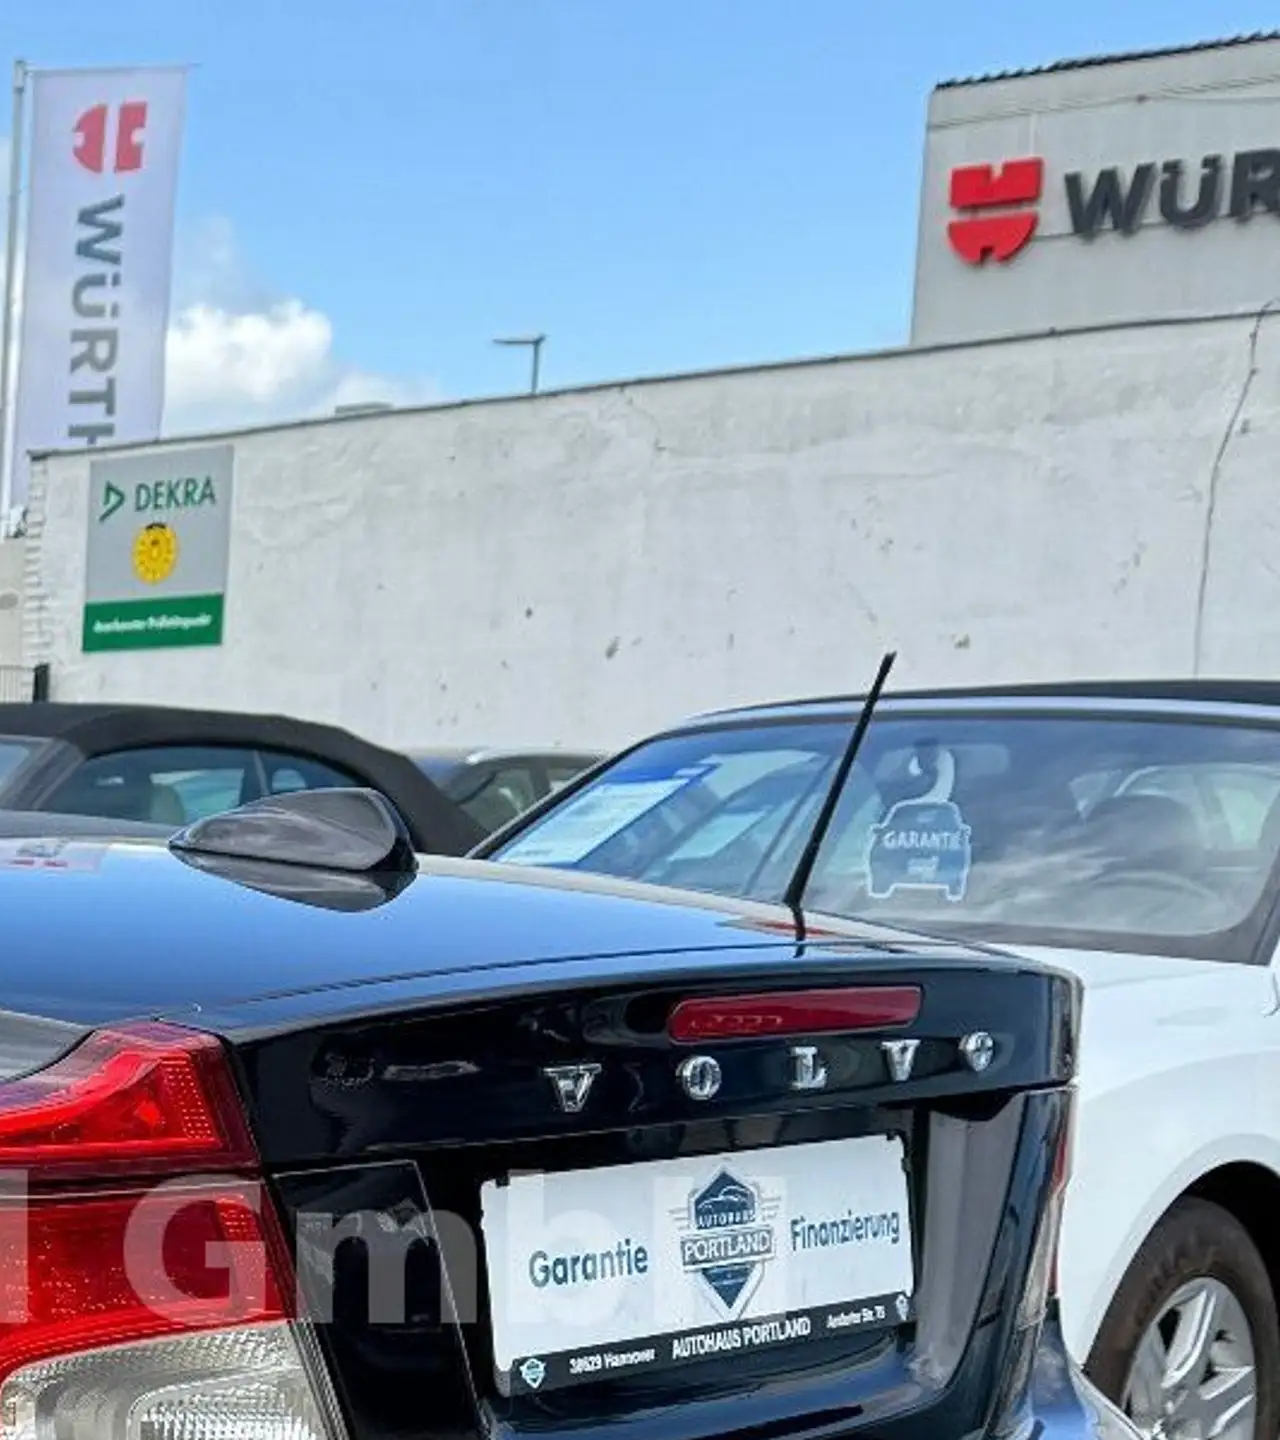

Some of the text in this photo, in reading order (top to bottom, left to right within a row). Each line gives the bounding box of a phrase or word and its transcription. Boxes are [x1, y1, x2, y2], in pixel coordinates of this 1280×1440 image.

[1063, 147, 1280, 238] WÜR
[134, 475, 217, 513] DEKRA
[542, 1030, 996, 1113] VOLVO
[684, 1230, 771, 1263] PORTLAND
[790, 1209, 901, 1253] Finanzierung
[528, 1238, 649, 1288] Garantie
[671, 1314, 812, 1361] AUTOHAUS PORTLAND
